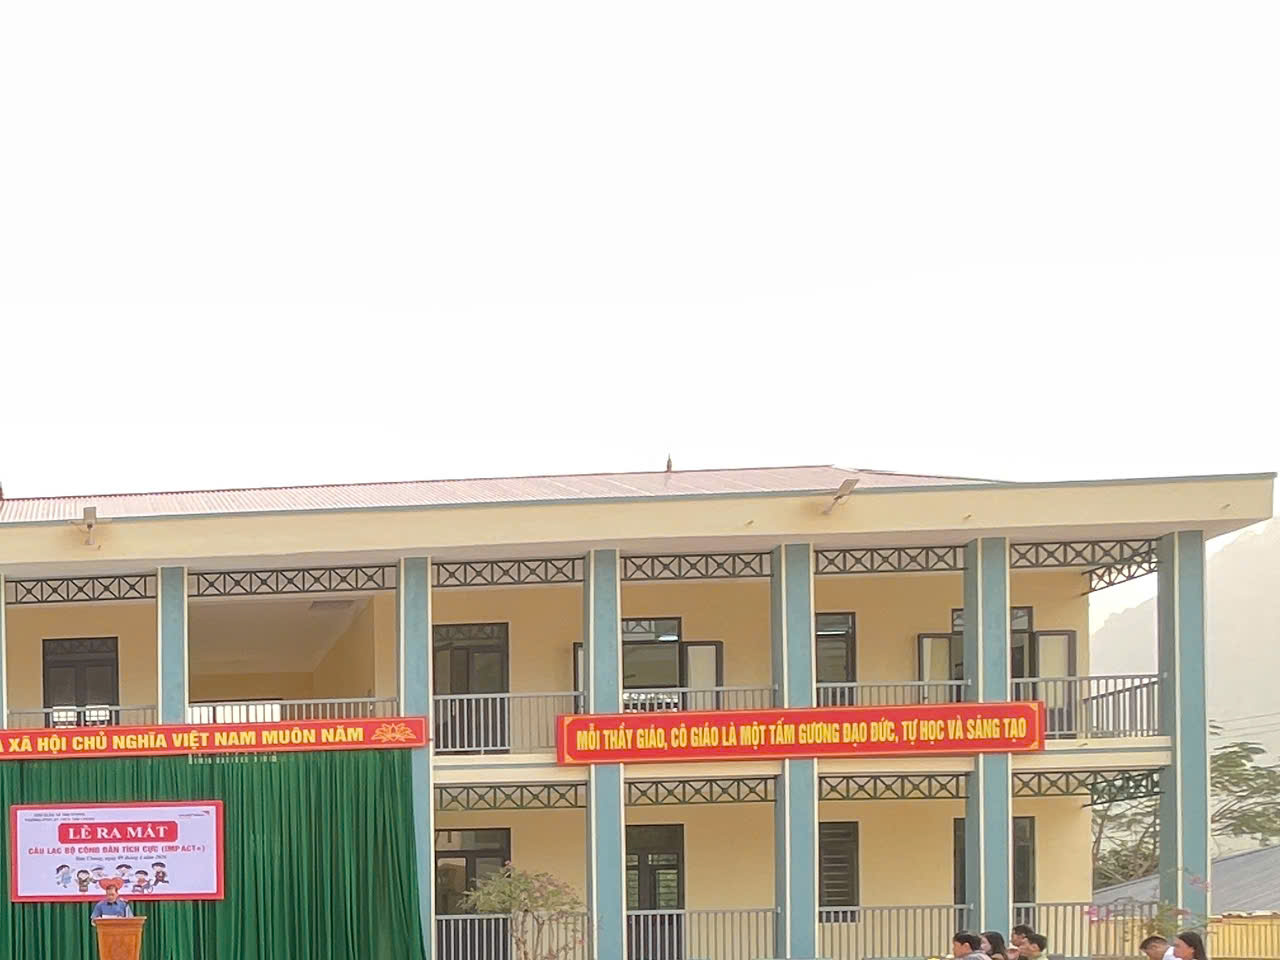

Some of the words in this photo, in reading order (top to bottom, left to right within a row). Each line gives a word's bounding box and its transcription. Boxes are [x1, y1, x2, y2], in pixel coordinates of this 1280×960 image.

[9, 735, 32, 753] XÃ
[37, 733, 67, 755] HỘI
[72, 731, 107, 750] CHỦ
[112, 730, 167, 750] NGHĨA
[171, 729, 209, 750] VIỆT
[214, 730, 257, 746] NAM
[261, 727, 316, 745] MUÔN
[321, 725, 364, 743] NĂM
[636, 724, 668, 751] GIÁO,
[671, 723, 687, 748] CÔ
[690, 721, 719, 747] GIÁO
[722, 721, 737, 746] LÀ
[740, 721, 766, 750] MỘT
[769, 717, 795, 744] TẤM
[798, 721, 840, 745] GƯƠNG
[843, 721, 868, 747] ĐẠO
[870, 717, 899, 743] ĐỨC,
[901, 718, 918, 745] TỰ
[920, 719, 945, 745] HỌC
[947, 715, 963, 740] VÀ
[966, 714, 1000, 739] SÁNG
[1003, 717, 1027, 743] TẠO
[97, 827, 122, 840] RA
